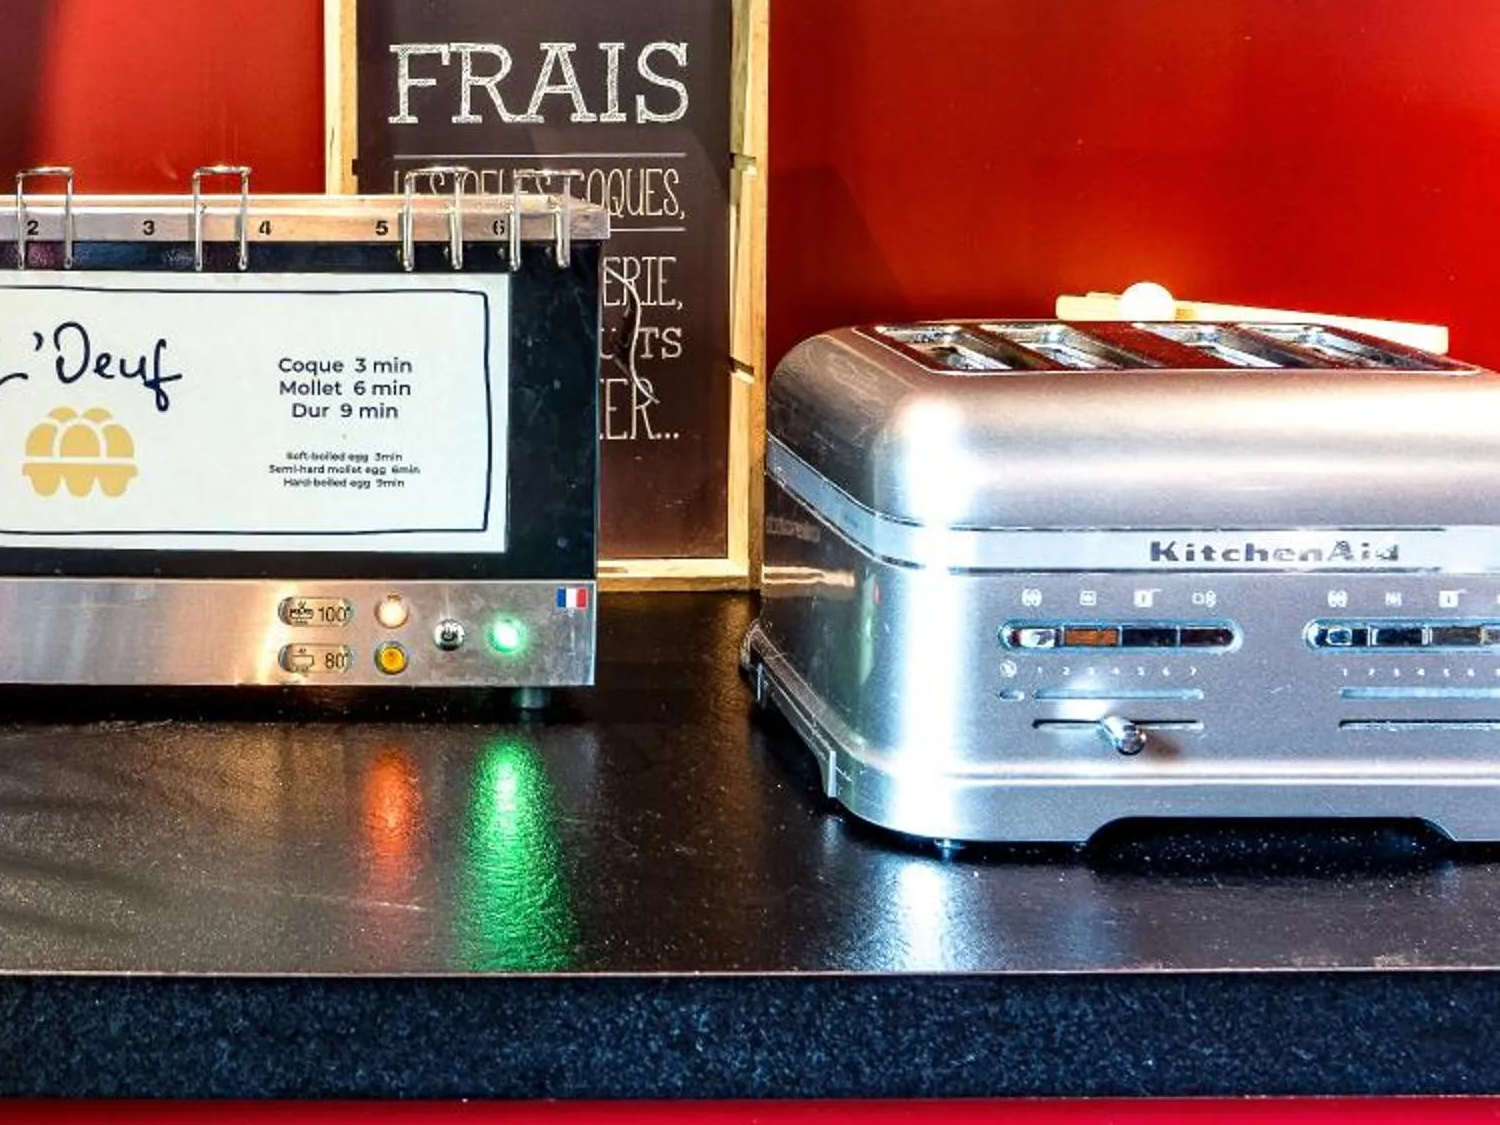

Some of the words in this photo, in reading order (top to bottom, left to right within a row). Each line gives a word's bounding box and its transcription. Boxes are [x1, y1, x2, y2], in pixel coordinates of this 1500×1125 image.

[388, 42, 689, 124] FRAIS
[27, 220, 39, 235] 2
[143, 220, 155, 235] 3
[259, 220, 271, 235] 4
[375, 220, 388, 235] 5
[493, 220, 505, 235] 6
[278, 357, 344, 376] Coque
[354, 357, 367, 373] 3
[373, 356, 413, 374] min
[279, 379, 343, 396] Mollet
[353, 380, 367, 396] 6
[371, 379, 411, 396] min
[291, 402, 330, 418] Dur
[340, 402, 353, 418] 9
[359, 402, 399, 418] min
[348, 453, 369, 463] egg
[268, 464, 325, 474] Semi-hard
[365, 465, 387, 476] egg
[349, 480, 371, 489] egg
[1149, 540, 1399, 562] KitchenAid
